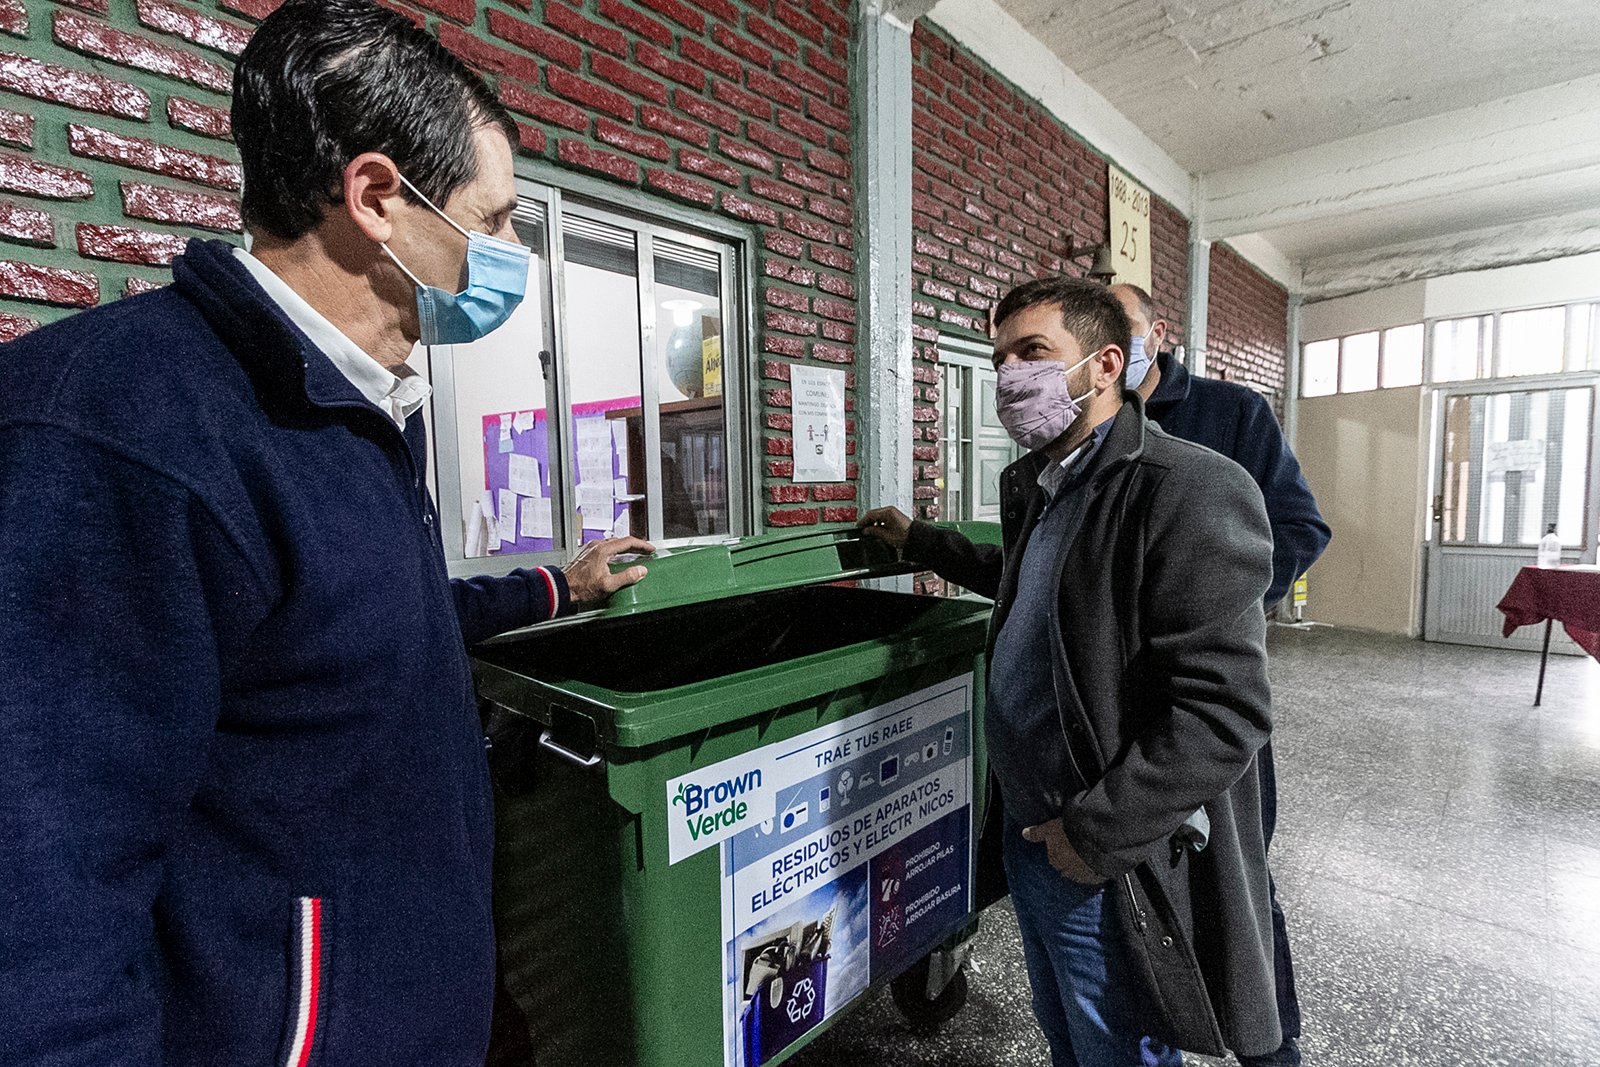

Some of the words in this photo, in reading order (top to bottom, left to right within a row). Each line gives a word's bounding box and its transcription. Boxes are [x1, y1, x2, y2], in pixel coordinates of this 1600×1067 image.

[1120, 221, 1137, 262] 25
[815, 738, 852, 768] TRAÉ
[855, 731, 879, 752] TUS
[882, 716, 913, 741] RAEE
[686, 768, 762, 817] Brown
[686, 800, 748, 841] Verde
[772, 828, 850, 879] RESIDUOS
[853, 816, 873, 836] DE
[875, 777, 941, 827] APARATOS
[751, 846, 850, 914] ELÉCTRICOS
[853, 839, 865, 856] Y
[905, 841, 941, 869] PROHIBIDO
[905, 855, 936, 881] ARROJAR
[936, 844, 954, 861] PILAS
[905, 885, 941, 915] PROHIBIDO
[905, 899, 936, 928] ARROJAR
[936, 883, 962, 906] BASURA
